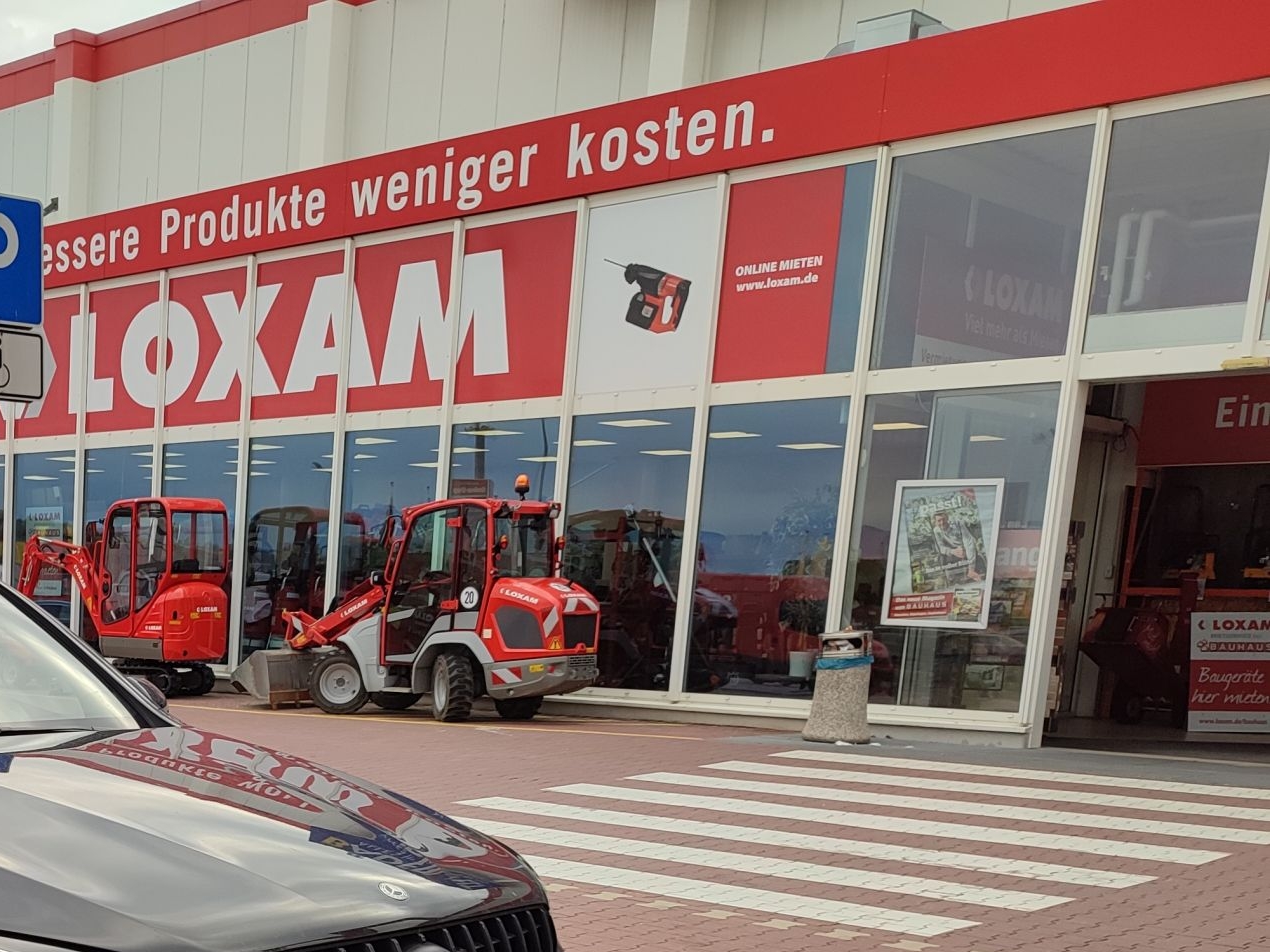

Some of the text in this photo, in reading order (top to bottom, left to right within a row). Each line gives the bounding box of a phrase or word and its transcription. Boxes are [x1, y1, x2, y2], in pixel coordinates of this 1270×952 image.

[41, 100, 776, 275] essere Produkte weniger kosten.
[734, 255, 823, 277] ONLINE MIETEN
[736, 272, 819, 292] www.loxam.de
[68, 248, 510, 415] LOXAM
[464, 591, 474, 605] 20
[504, 589, 539, 605] LOXAM
[343, 598, 368, 617] LOXAM
[1212, 619, 1270, 631] LOXAM
[1198, 666, 1265, 692] Baugeräte
[1191, 689, 1220, 704] hier
